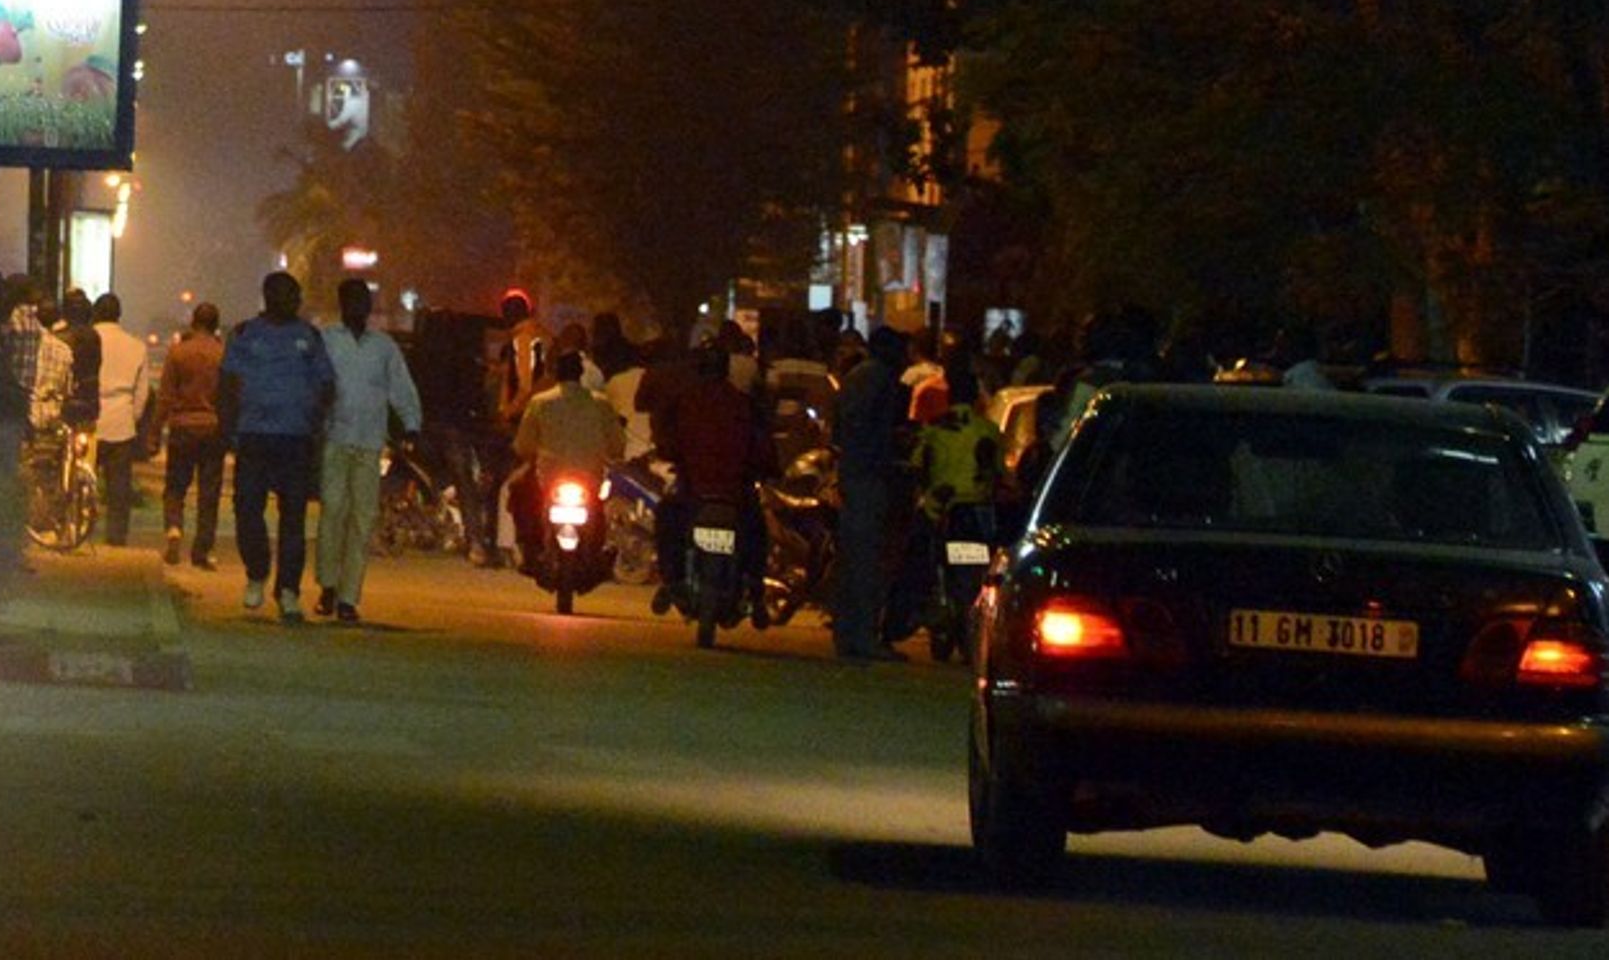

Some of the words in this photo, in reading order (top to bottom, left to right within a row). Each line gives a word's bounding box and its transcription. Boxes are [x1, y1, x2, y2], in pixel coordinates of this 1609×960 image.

[1234, 614, 1260, 642] 11
[1276, 617, 1313, 647] GM
[1327, 620, 1385, 652] 3018
